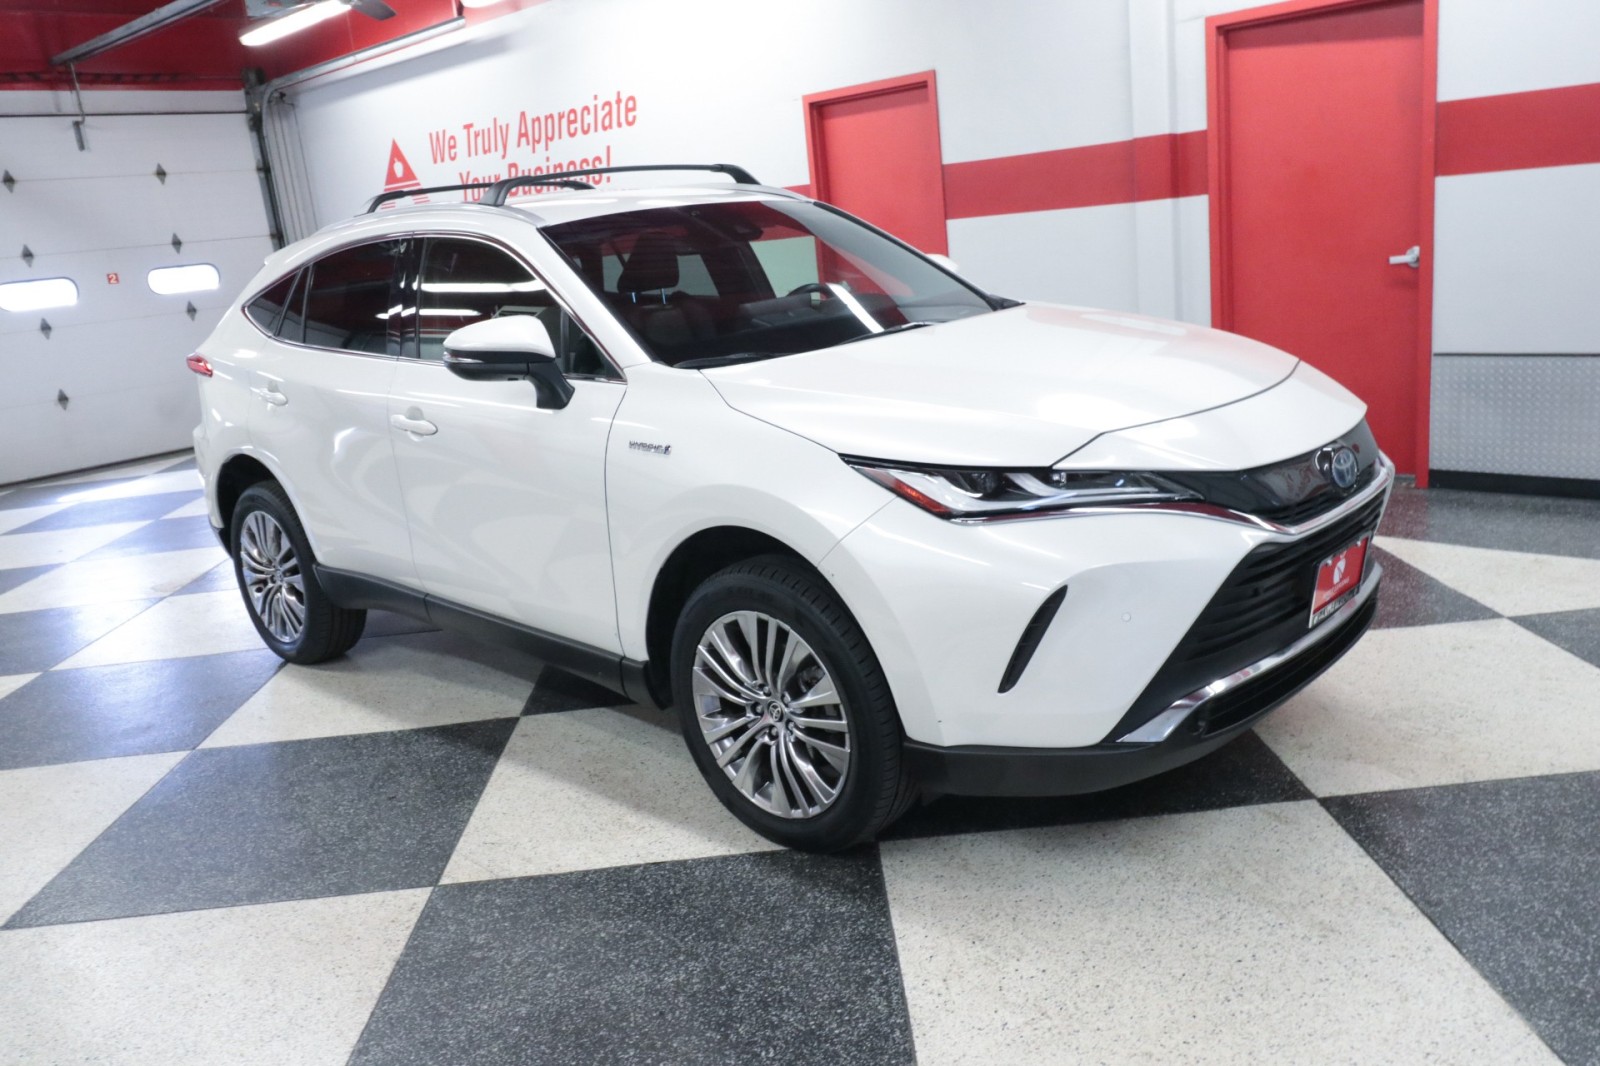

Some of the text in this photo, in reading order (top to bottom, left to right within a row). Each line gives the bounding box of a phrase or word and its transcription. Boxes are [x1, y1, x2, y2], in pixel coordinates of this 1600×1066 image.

[429, 91, 637, 164] We Truly Appreciate
[108, 274, 118, 284] 2
